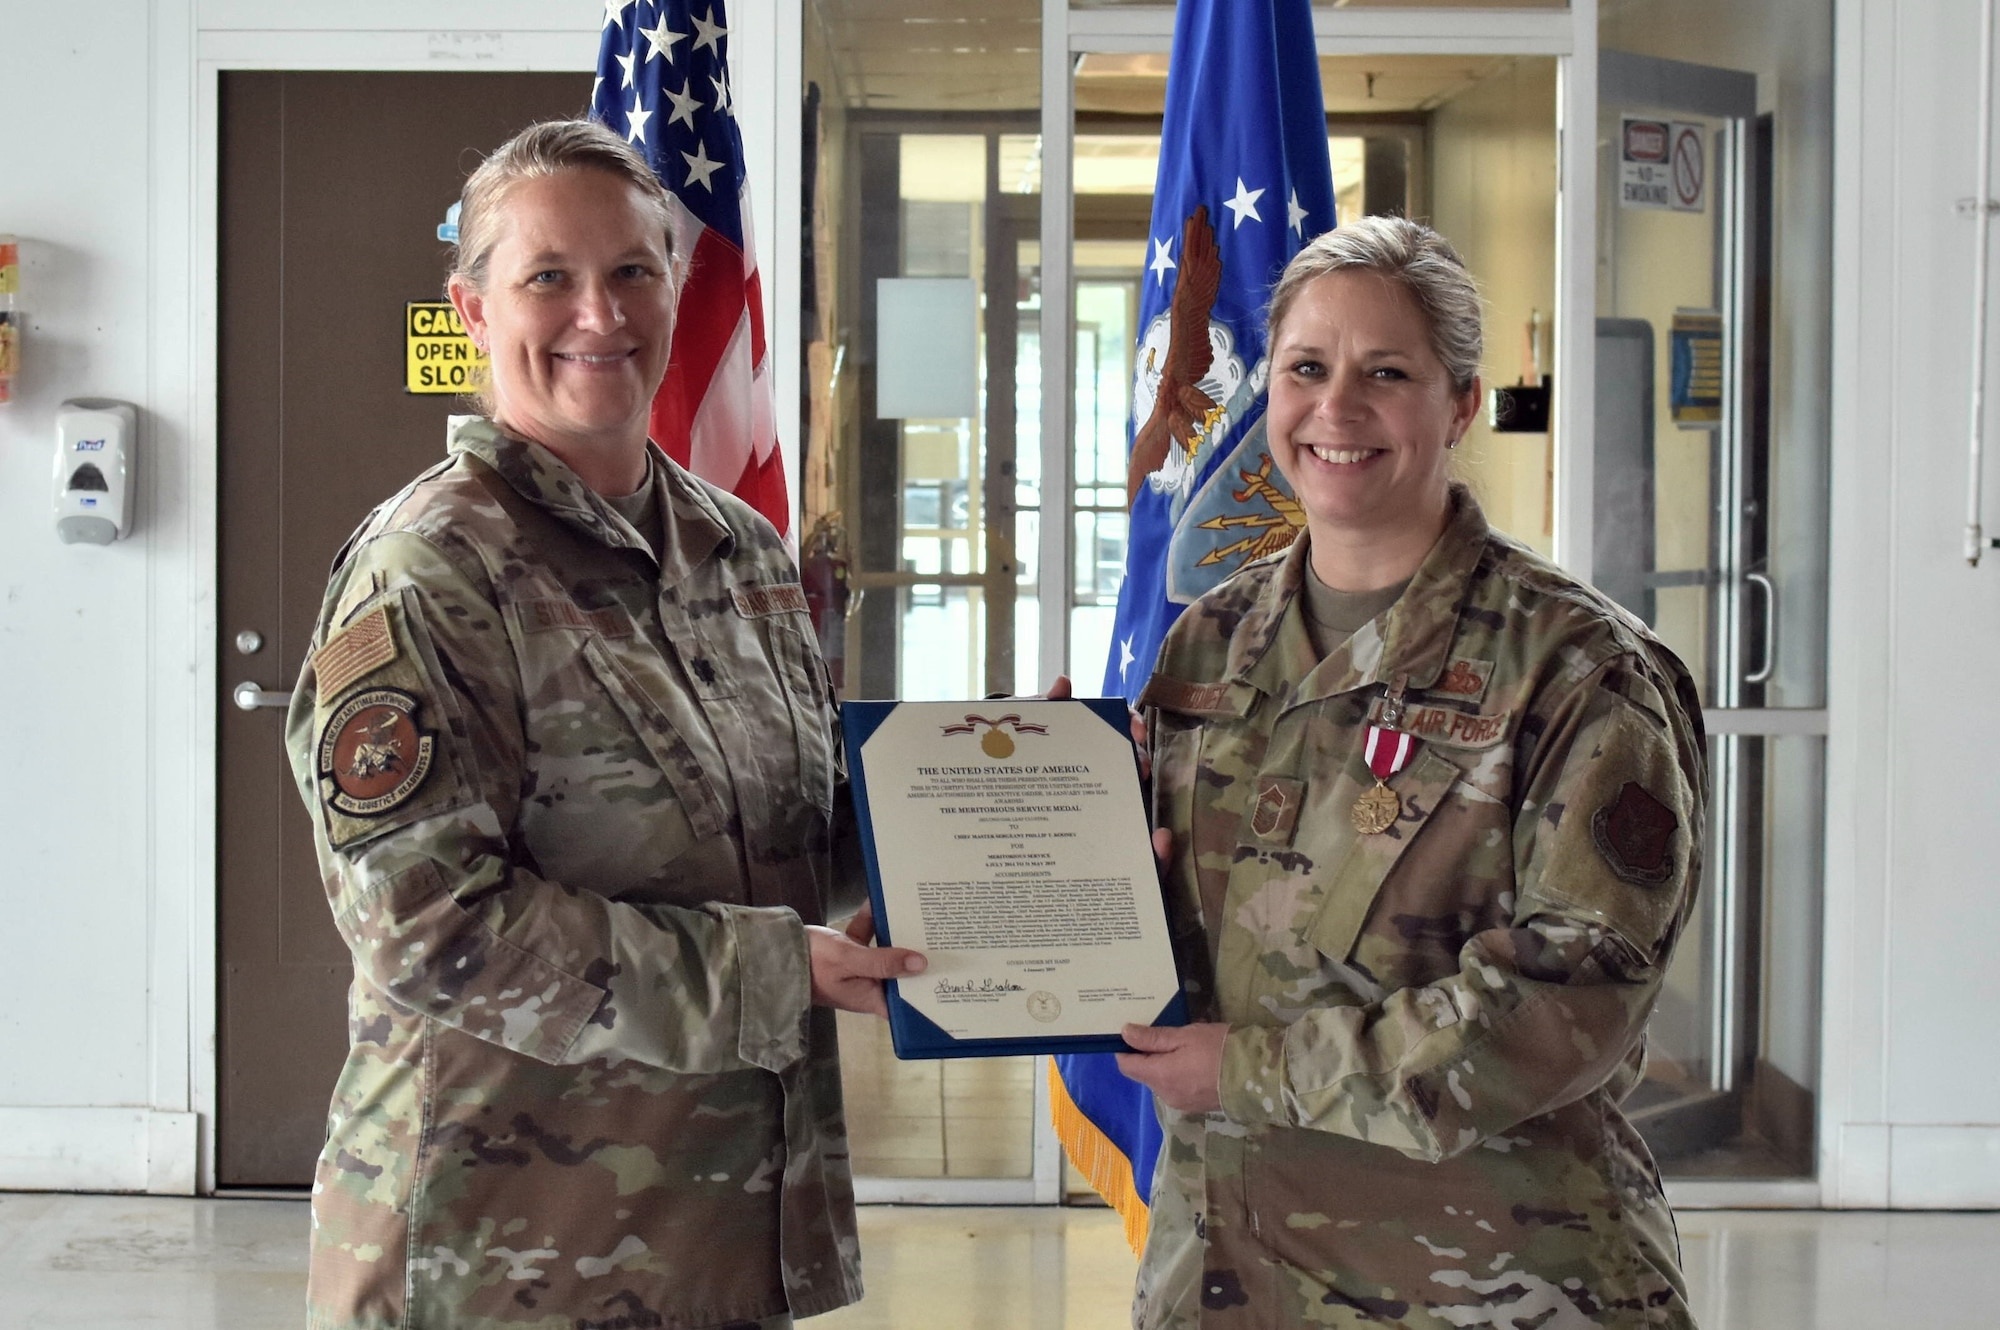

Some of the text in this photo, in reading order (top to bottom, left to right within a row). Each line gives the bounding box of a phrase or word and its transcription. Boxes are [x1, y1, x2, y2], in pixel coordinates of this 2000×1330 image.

[1624, 182, 1667, 204] SMOKING
[413, 309, 465, 335] CAU
[416, 343, 467, 360] OPEN
[343, 694, 374, 718] ANYTIME
[1410, 708, 1447, 733] AIR
[917, 765, 1090, 775] THE UNITED STATES OF AMERICA
[357, 793, 397, 811] LOGISTICS
[398, 755, 430, 796] READINESS
